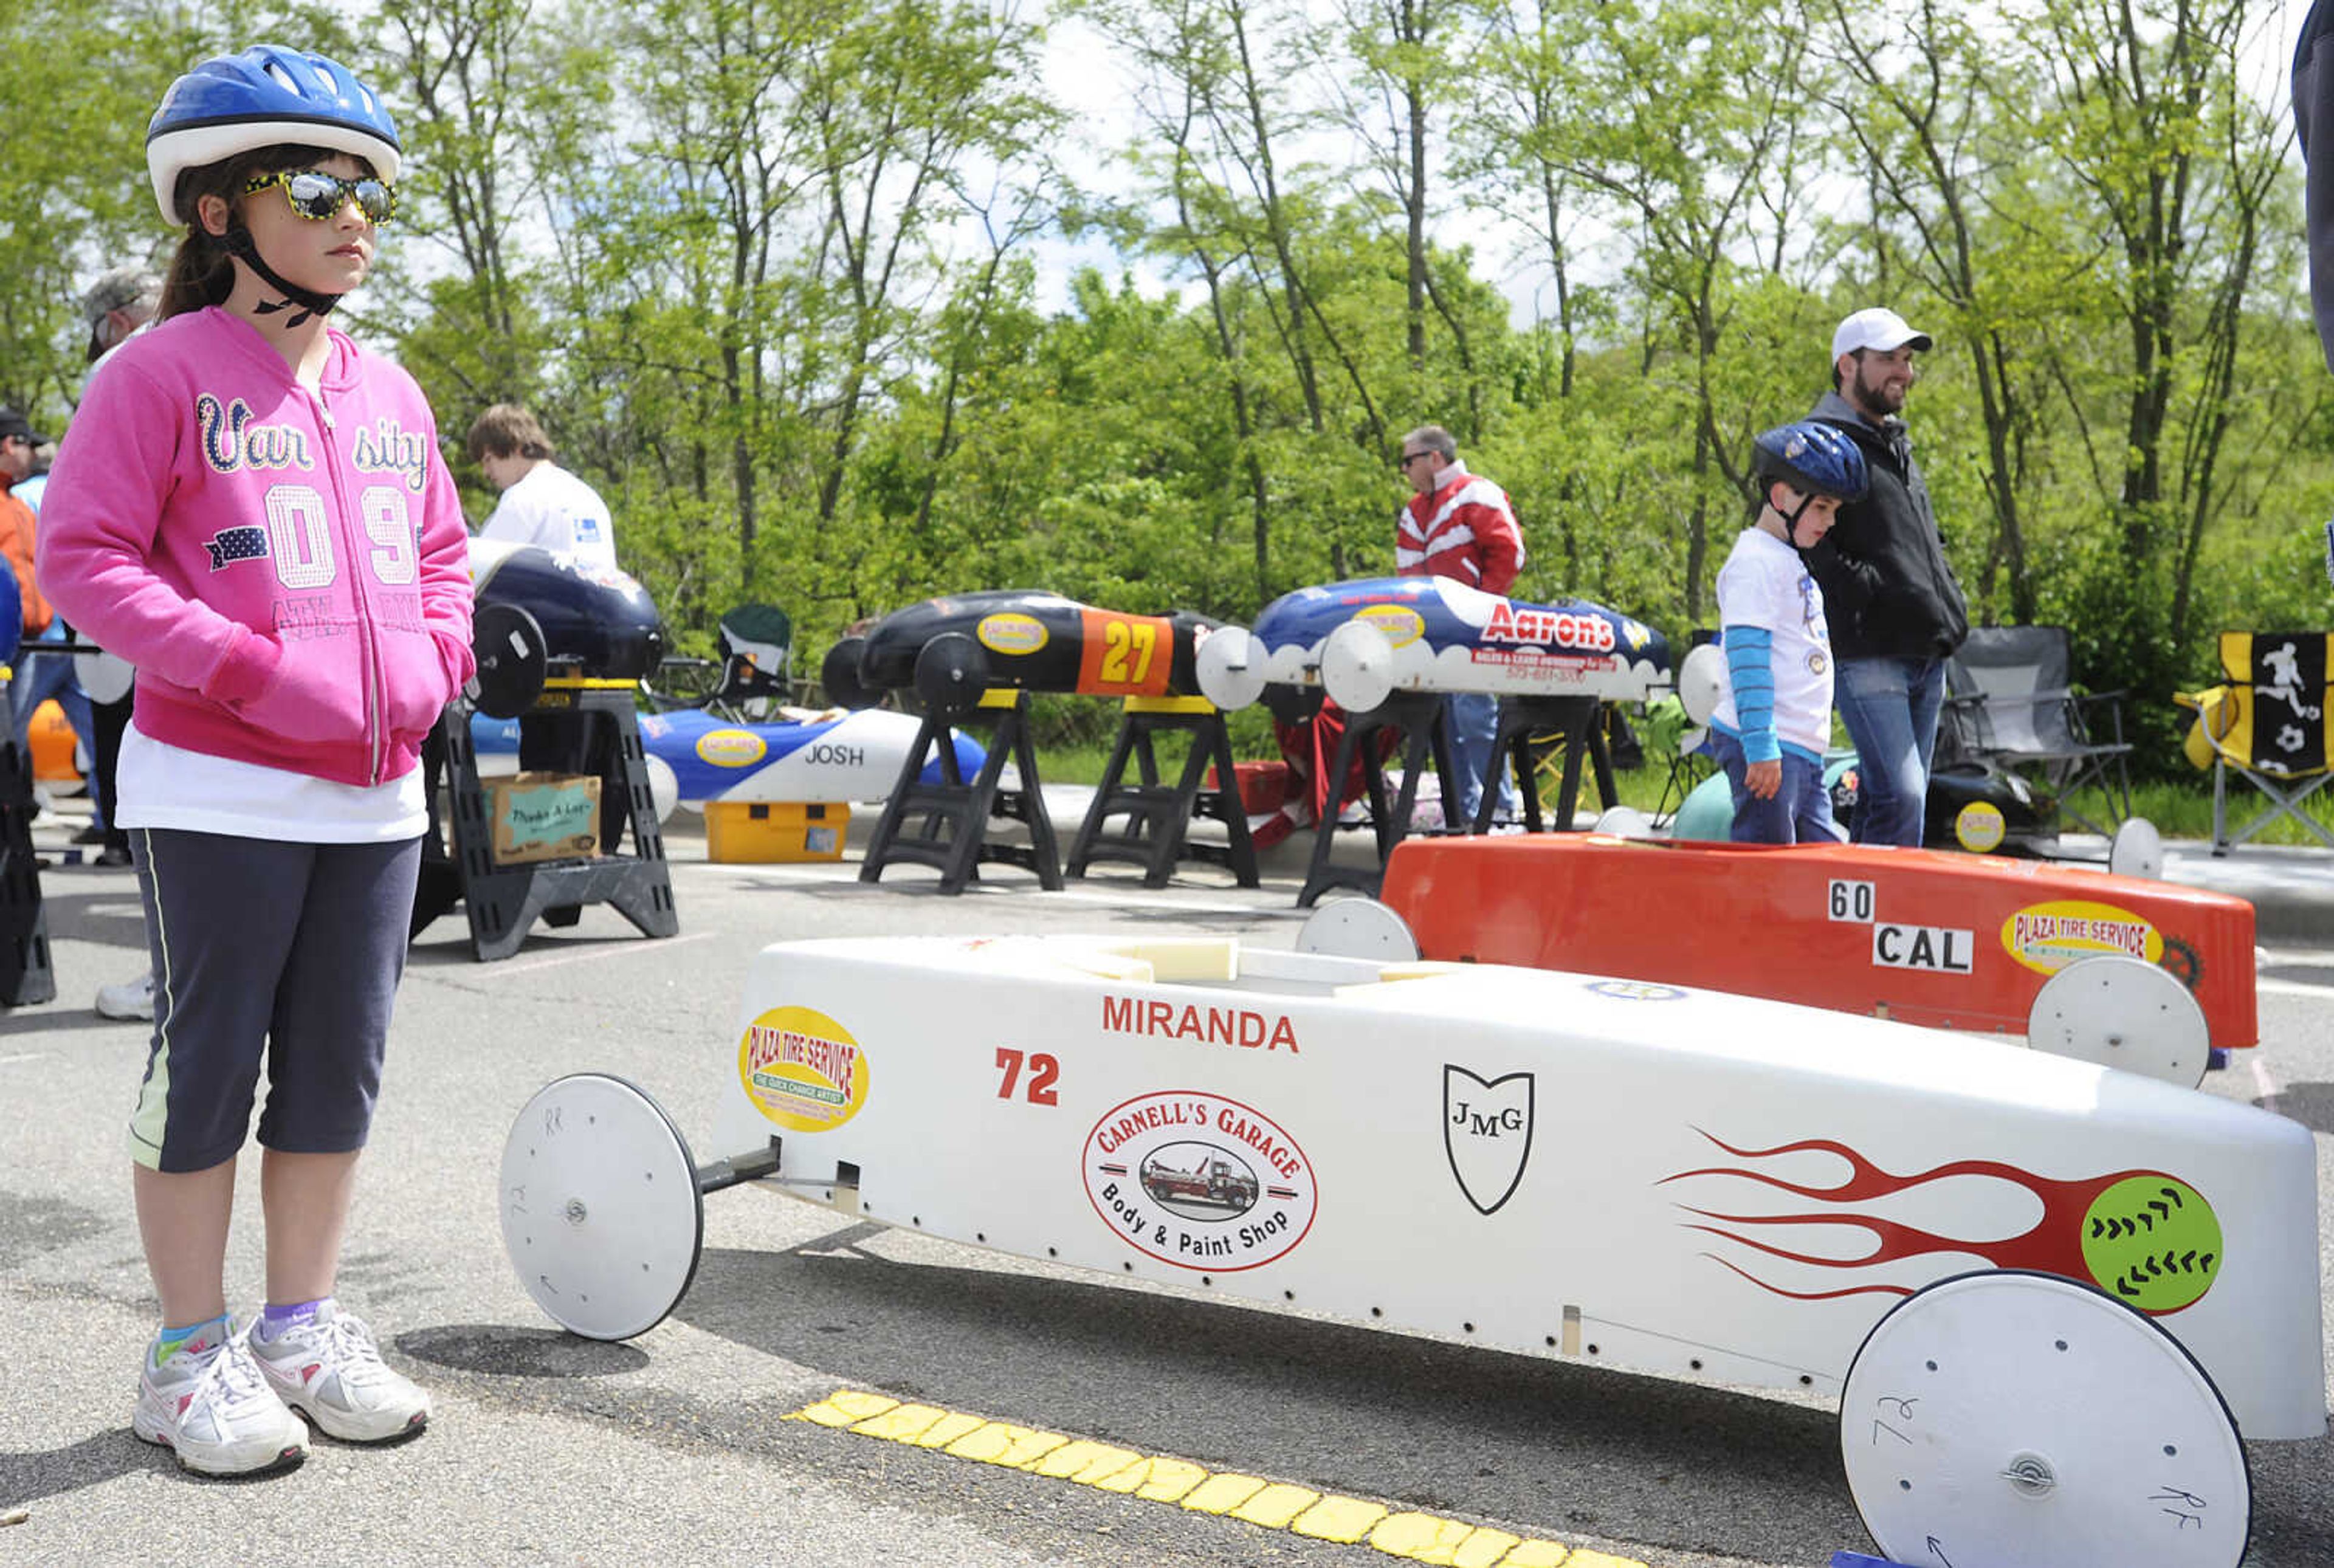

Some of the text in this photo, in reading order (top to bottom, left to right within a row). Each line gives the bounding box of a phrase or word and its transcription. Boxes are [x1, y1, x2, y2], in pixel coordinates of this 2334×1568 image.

[1100, 620, 1155, 683] 27
[1483, 602, 1614, 650] Aaron's
[805, 745, 864, 766] JOSH
[1831, 882, 1871, 919] 60
[1877, 927, 1969, 970] CAL
[2014, 915, 2056, 949] PLAZA
[2060, 919, 2087, 938] TIRE
[2091, 921, 2146, 958] SERVICE
[1103, 995, 1299, 1053] MIRANDA
[747, 1027, 854, 1099] PLAZA TIRE SERVICE
[996, 1047, 1060, 1107] 72
[1098, 1102, 1300, 1180] CARNELL'S GARAGE
[1453, 1102, 1523, 1137] JMG
[1102, 1183, 1288, 1256] Body & Paint Shop
